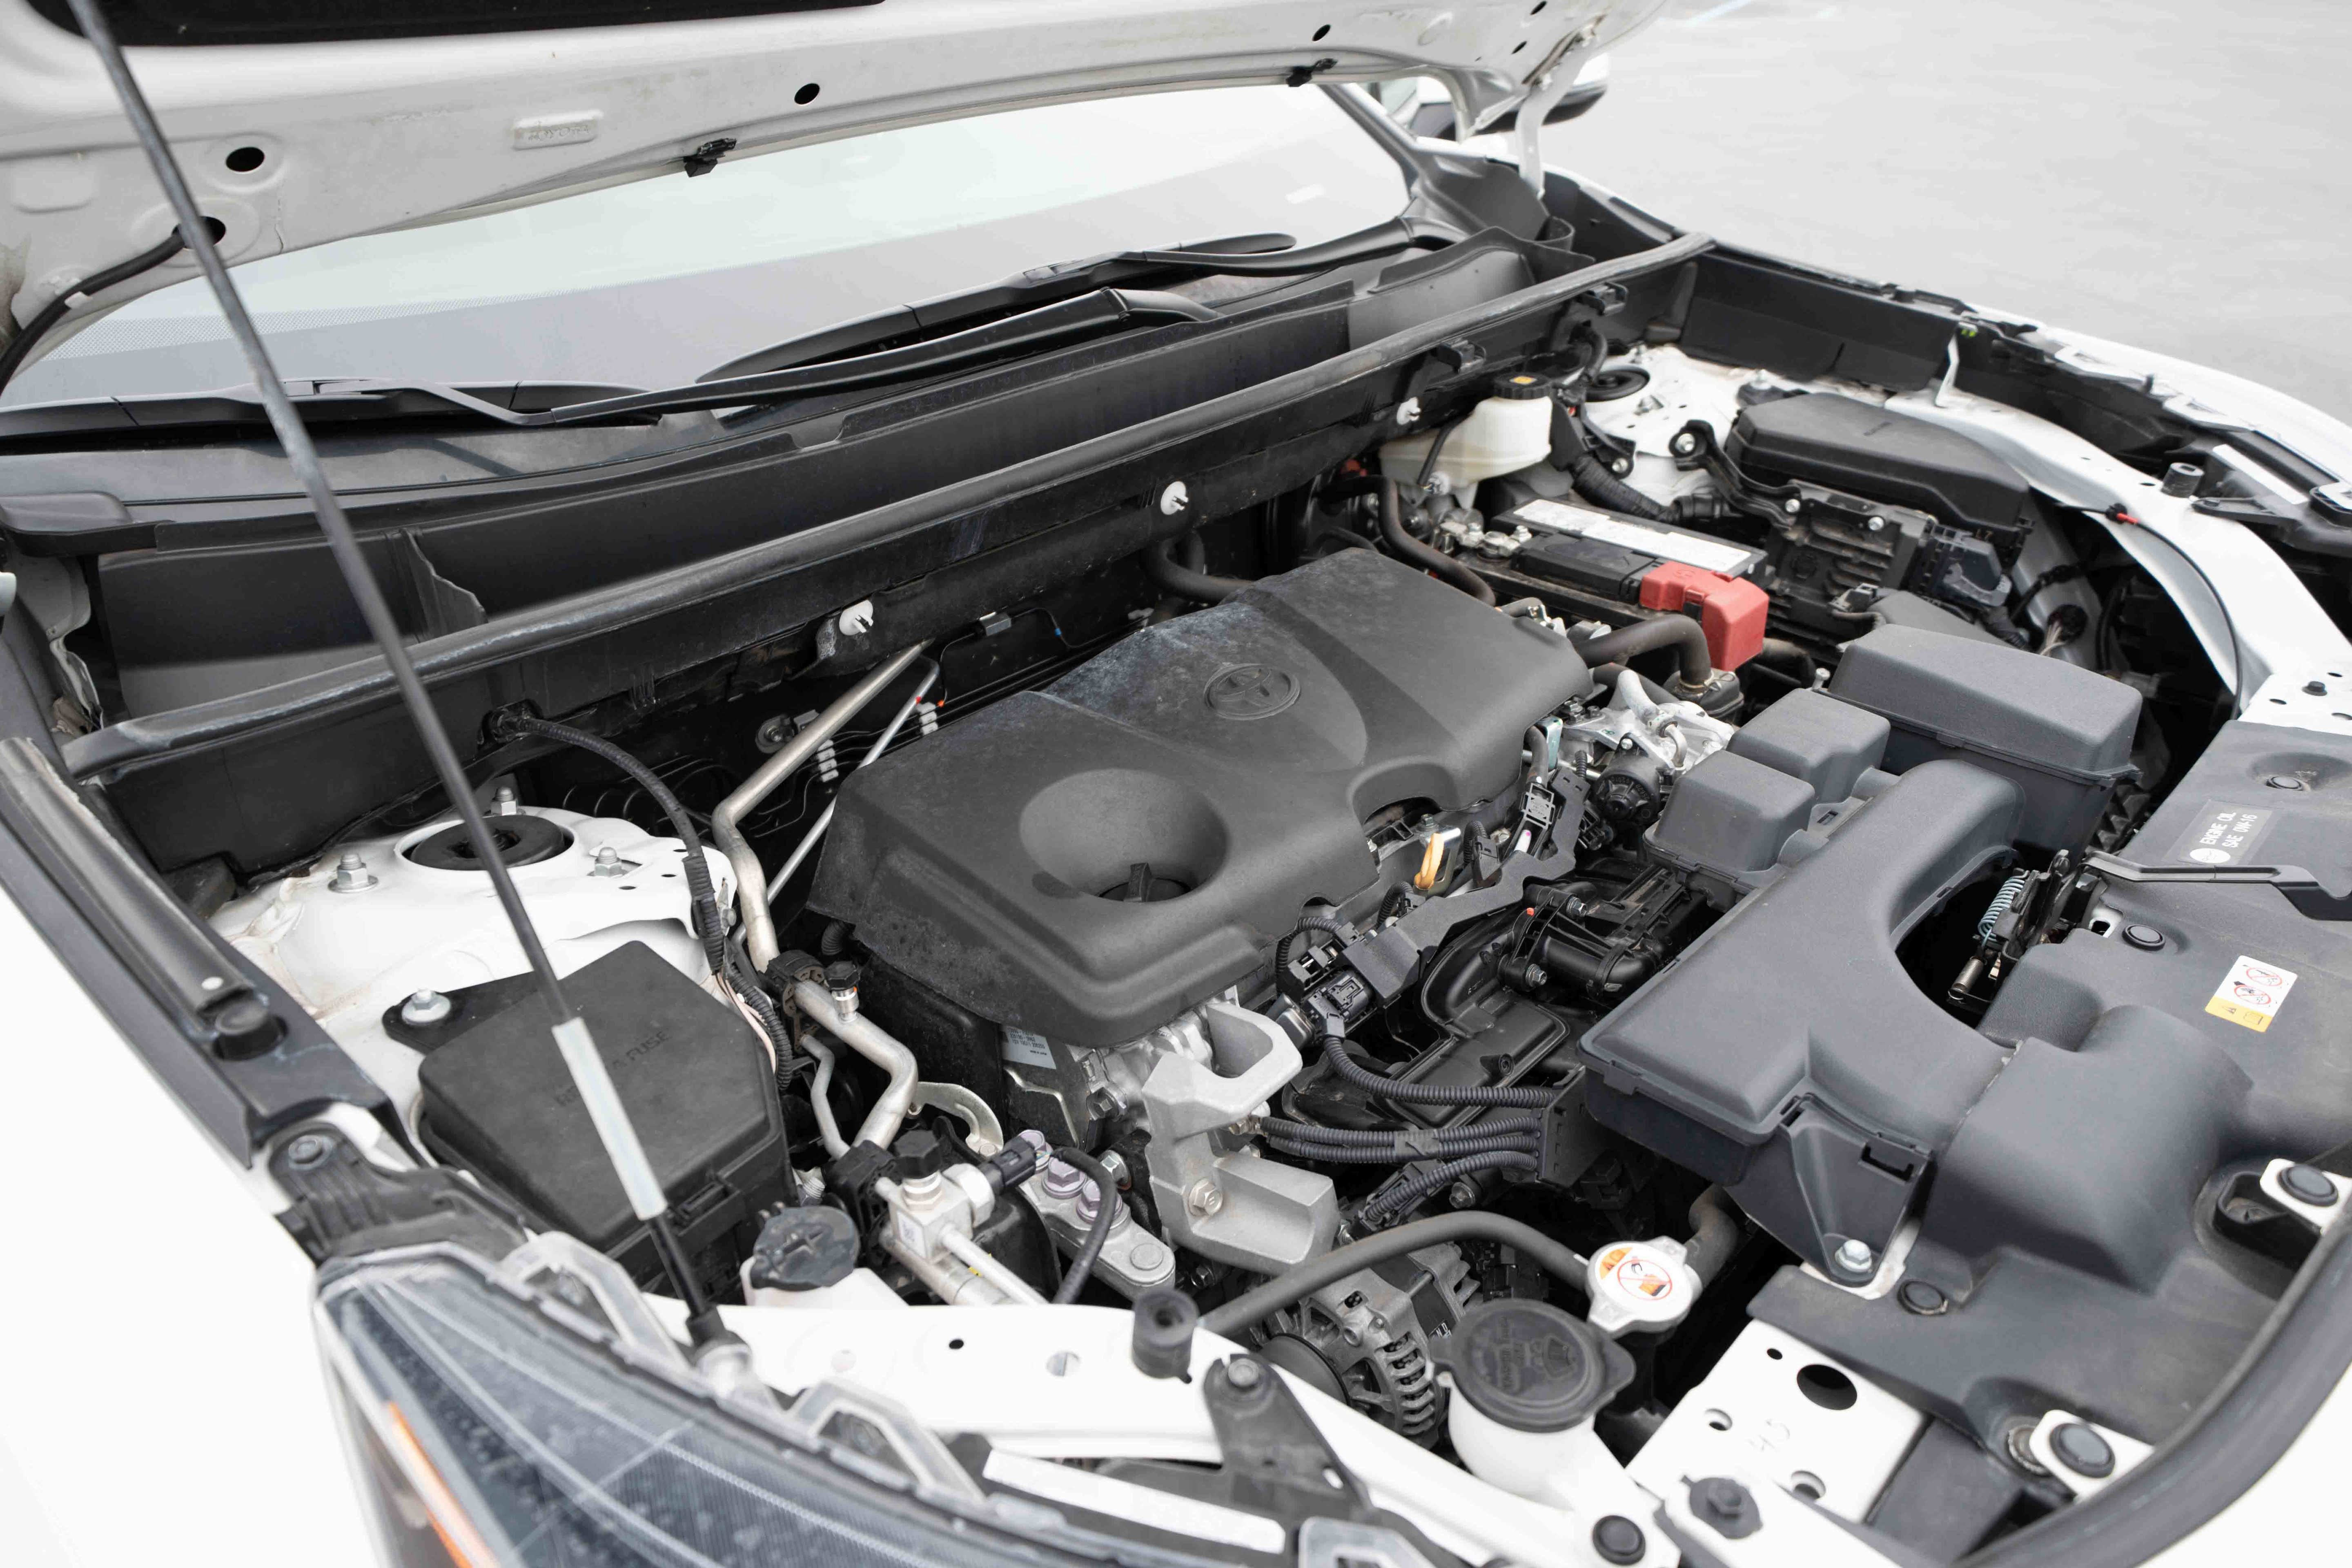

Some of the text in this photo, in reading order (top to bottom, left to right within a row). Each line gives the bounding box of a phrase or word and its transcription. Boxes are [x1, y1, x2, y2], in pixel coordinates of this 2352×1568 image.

[2199, 812, 2236, 845] ENGINE OIL
[2222, 814, 2258, 848] SAE 0W-16
[626, 1027, 673, 1061] FUSE
